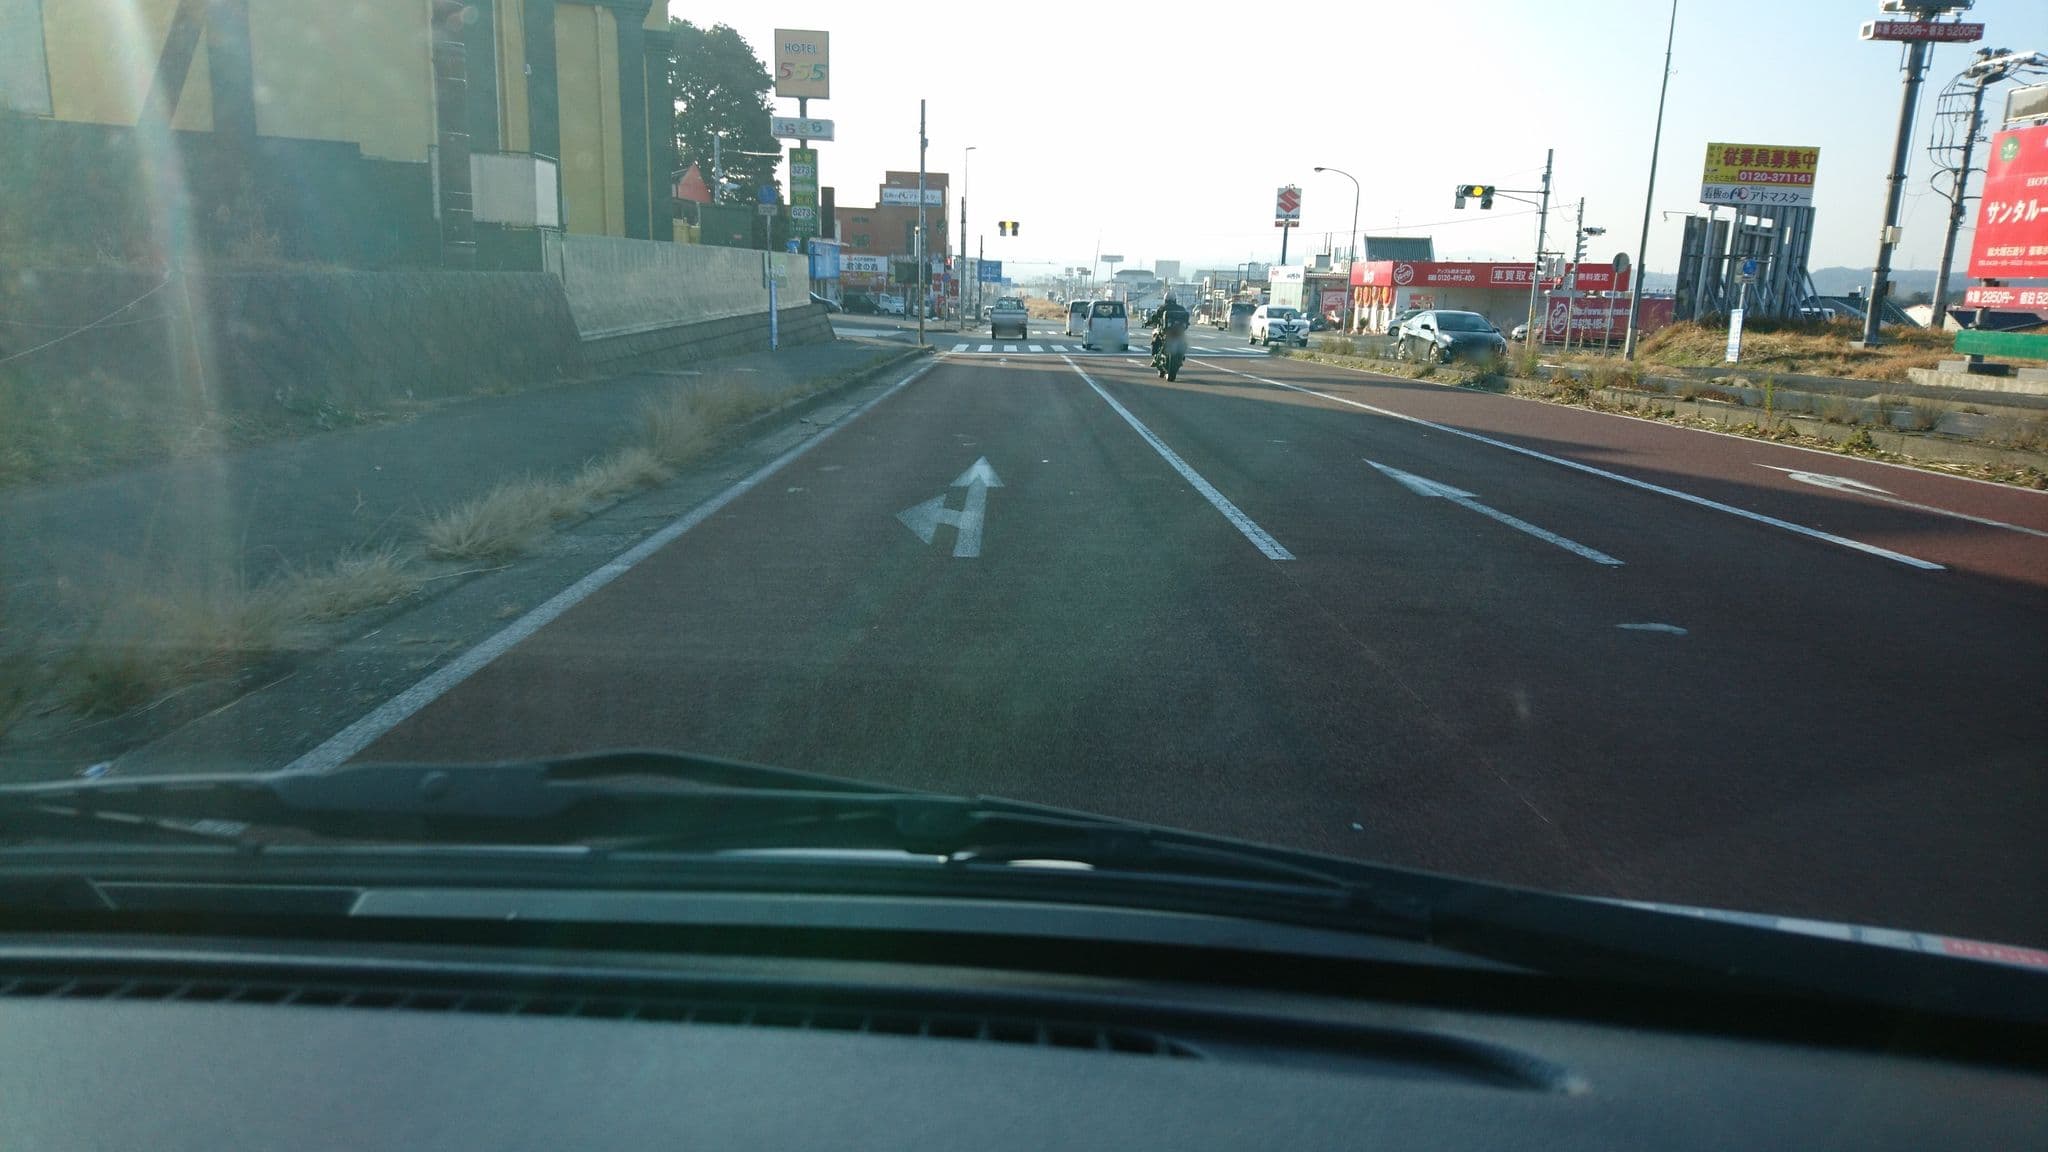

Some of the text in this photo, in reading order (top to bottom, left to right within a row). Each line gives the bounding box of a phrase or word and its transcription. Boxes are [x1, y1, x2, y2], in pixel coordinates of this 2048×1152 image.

[784, 43, 816, 54] HOTEL
[779, 62, 826, 81] 555
[1724, 147, 1816, 169] 従業員募集中
[1740, 172, 1811, 183] 0120-371141
[1750, 191, 1810, 202] アドマスター
